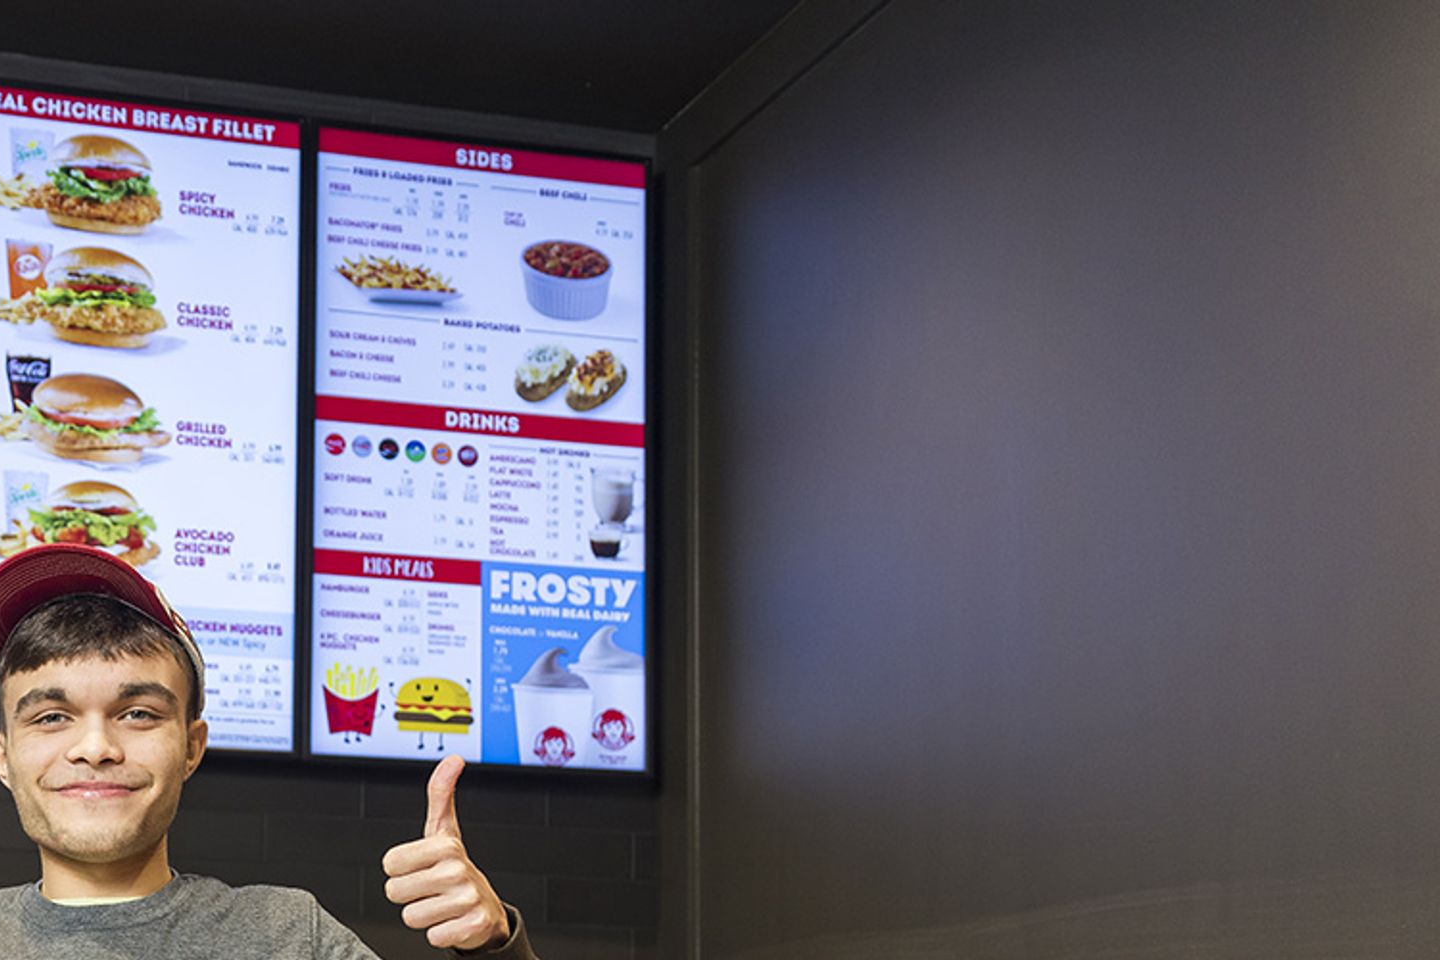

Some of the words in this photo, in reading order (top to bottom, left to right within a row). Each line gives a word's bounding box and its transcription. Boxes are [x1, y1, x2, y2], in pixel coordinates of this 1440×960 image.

[32, 96, 126, 124] CHICKEN
[132, 109, 208, 134] BREAST
[212, 118, 276, 142] FILLET
[455, 148, 513, 170] SIDES
[353, 167, 379, 178] FRIES
[179, 190, 216, 204] SPICY
[178, 203, 235, 219] CHICKEN
[177, 302, 230, 317] CLASSIC
[177, 315, 233, 330] CHICKEN
[176, 420, 226, 435] GRILLED
[445, 411, 520, 434] DRINKS
[176, 434, 233, 448] CHICKEN
[175, 529, 235, 542] AVOCADO
[174, 541, 230, 555] CHICKEN
[174, 554, 205, 567] CLUB
[363, 556, 392, 575] KIDS
[394, 559, 435, 579] MEALS
[490, 570, 637, 608] FROSTY
[490, 603, 526, 616] MADE
[529, 606, 560, 618] WITH
[562, 608, 591, 620] REAL
[593, 610, 631, 623] DAIRY
[187, 620, 227, 632] ICKEN
[229, 624, 283, 637] NUGGETS
